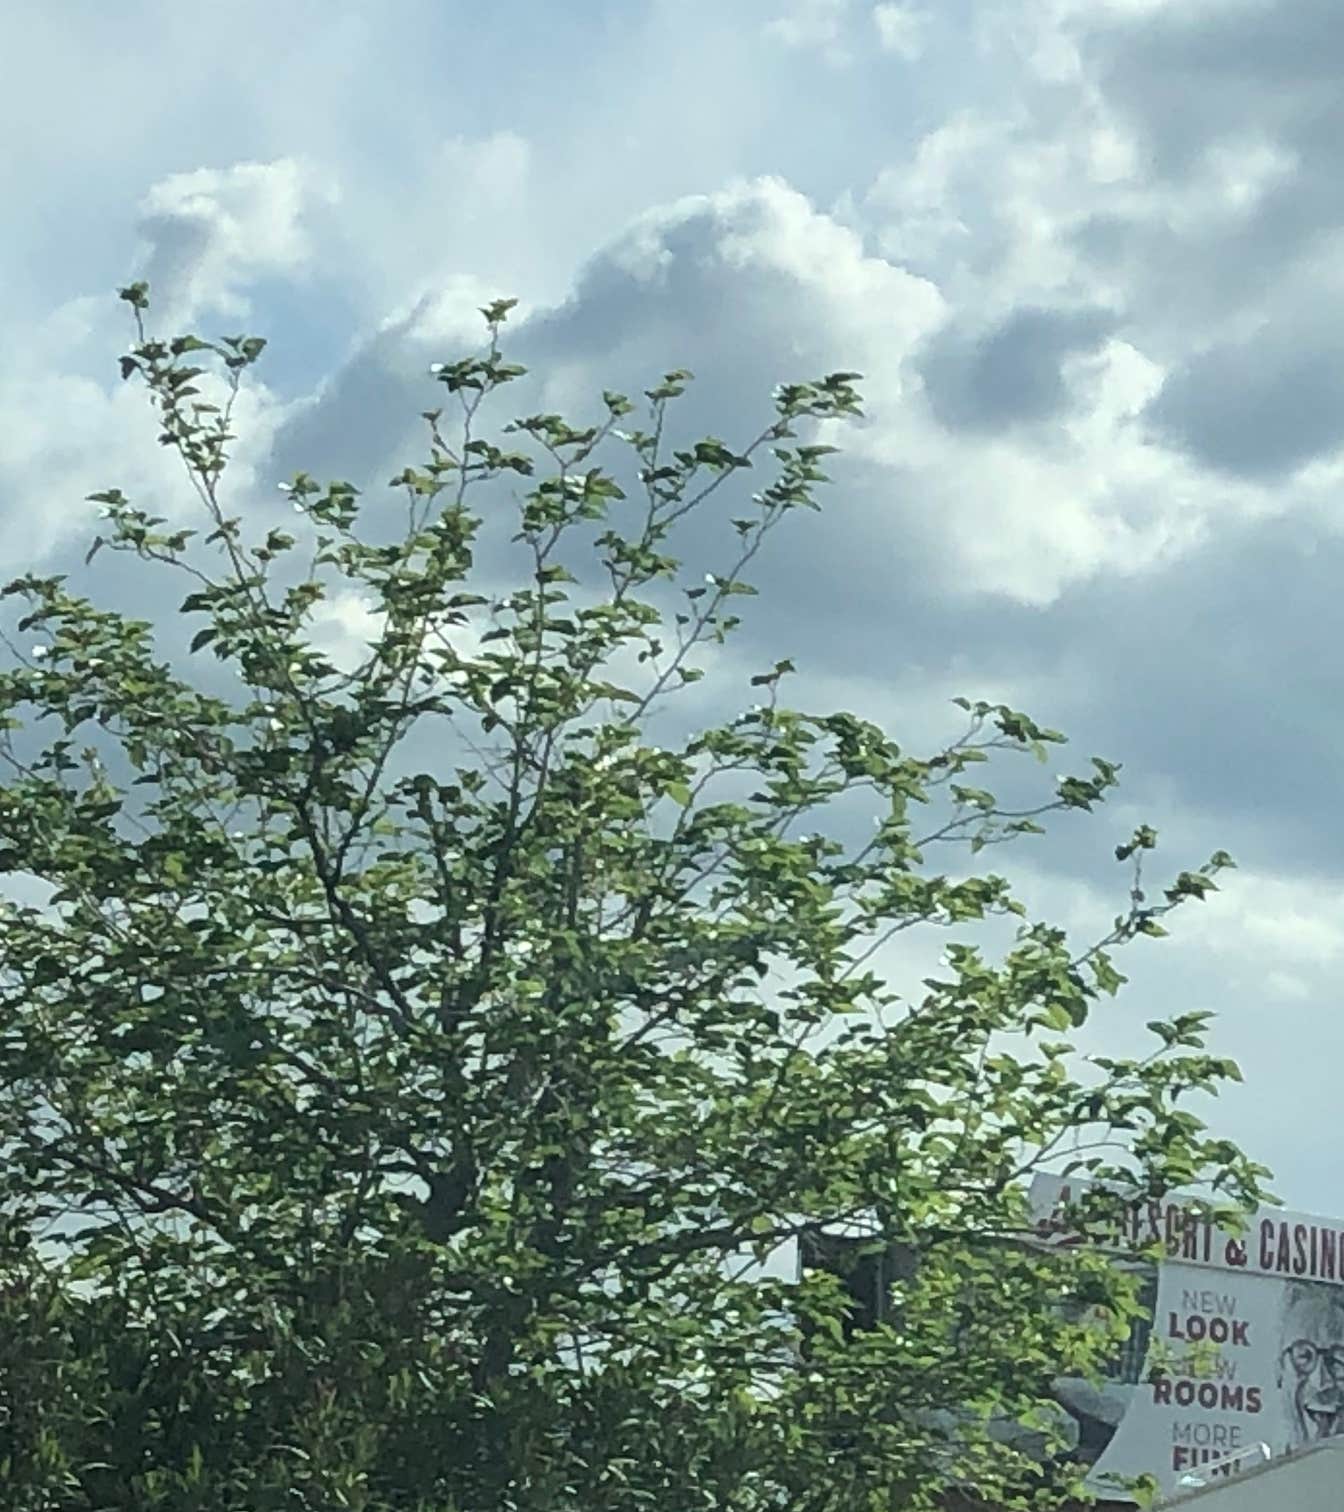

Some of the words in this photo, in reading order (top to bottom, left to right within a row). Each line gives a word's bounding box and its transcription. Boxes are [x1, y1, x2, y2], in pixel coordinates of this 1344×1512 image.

[1182, 1289, 1237, 1316] NEW
[1169, 1311, 1250, 1347] LOOK
[1182, 1354, 1237, 1380] NW
[1154, 1379, 1262, 1413] ROOMS
[1172, 1420, 1242, 1448] MORE
